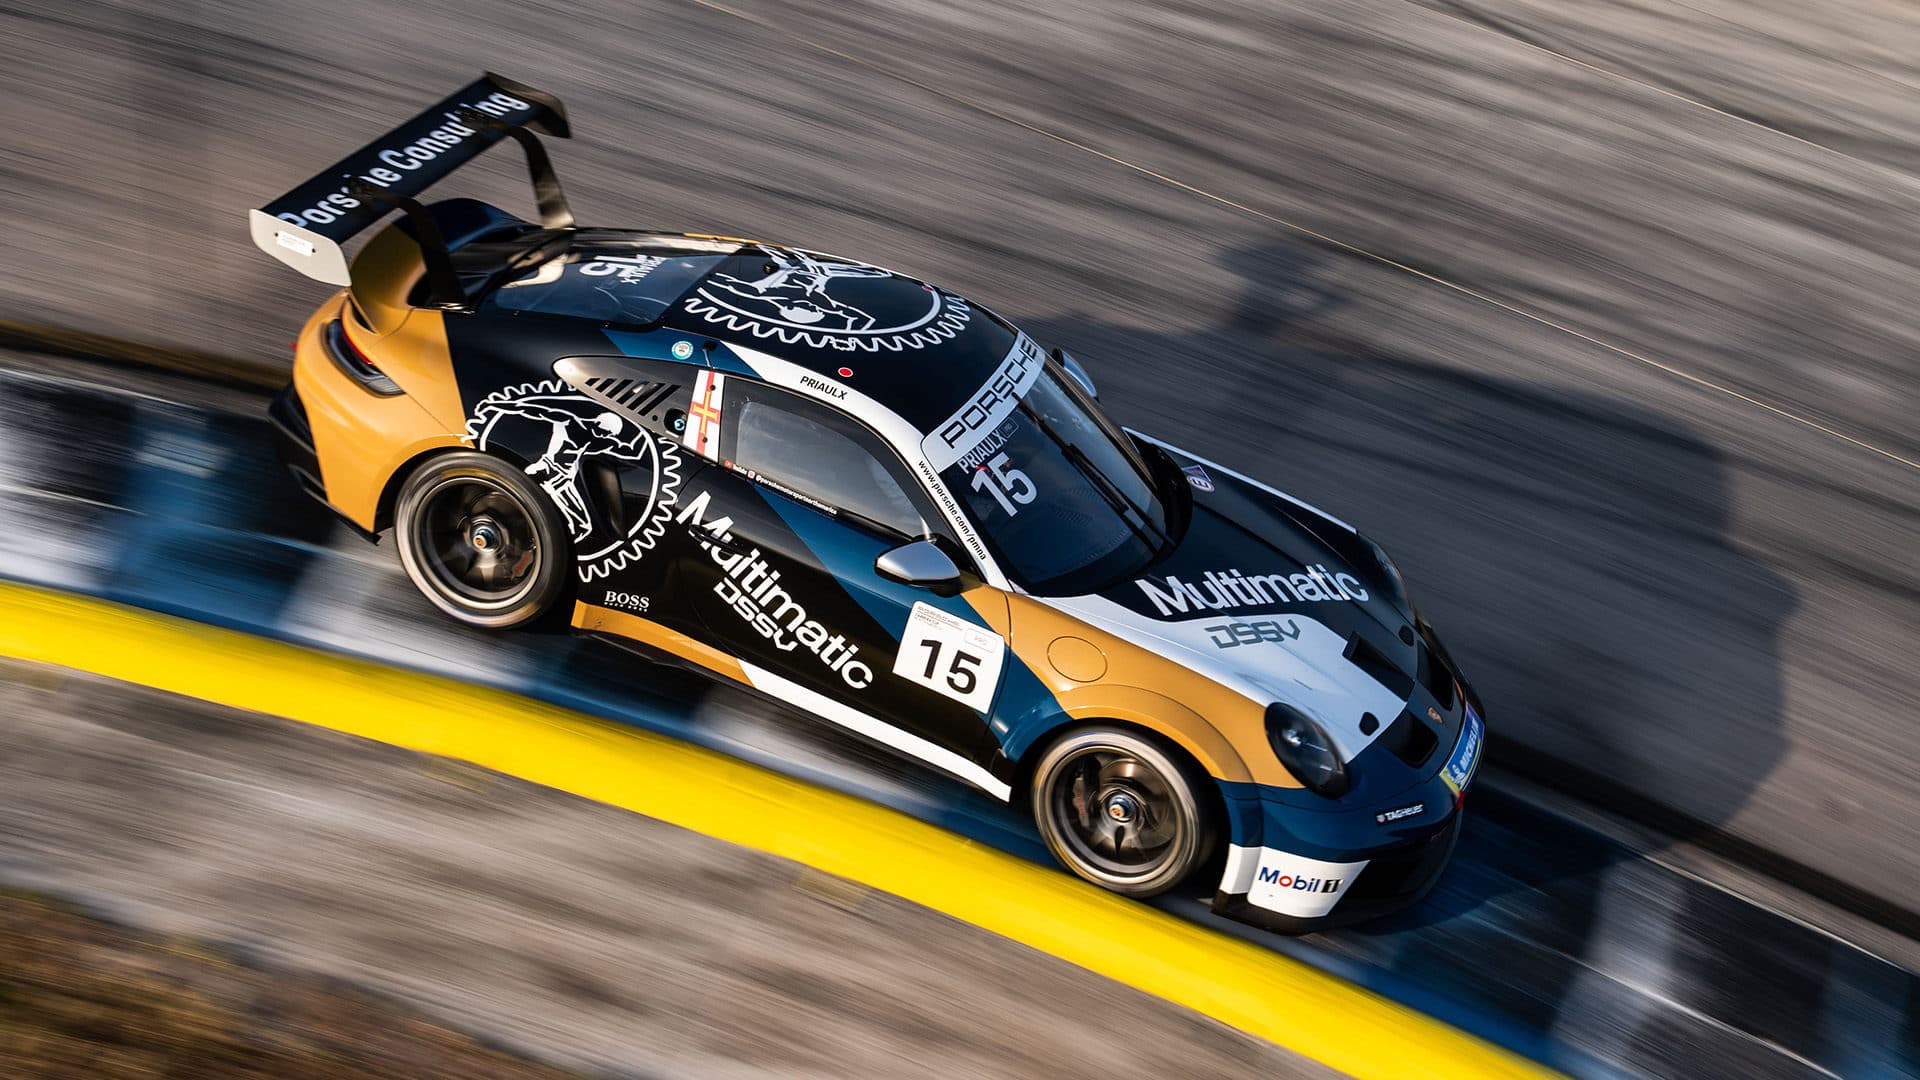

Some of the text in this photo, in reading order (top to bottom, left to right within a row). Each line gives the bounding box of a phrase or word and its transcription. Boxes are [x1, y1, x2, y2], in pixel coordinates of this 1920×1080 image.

[579, 255, 643, 278] 15
[800, 375, 848, 401] PRIAULX
[940, 338, 1037, 449] PORSCHE
[958, 428, 1007, 475] PRIAULX
[918, 459, 987, 561] www.porsche.com/pmna
[971, 452, 1038, 518] 15
[604, 590, 650, 609] BOSS
[675, 490, 874, 690] Multimatic
[713, 581, 799, 652] DSSV
[1134, 564, 1370, 617] Multimatic
[1204, 619, 1301, 649] DSSV
[920, 638, 982, 695] 15
[1258, 866, 1340, 893] Mobil 1
